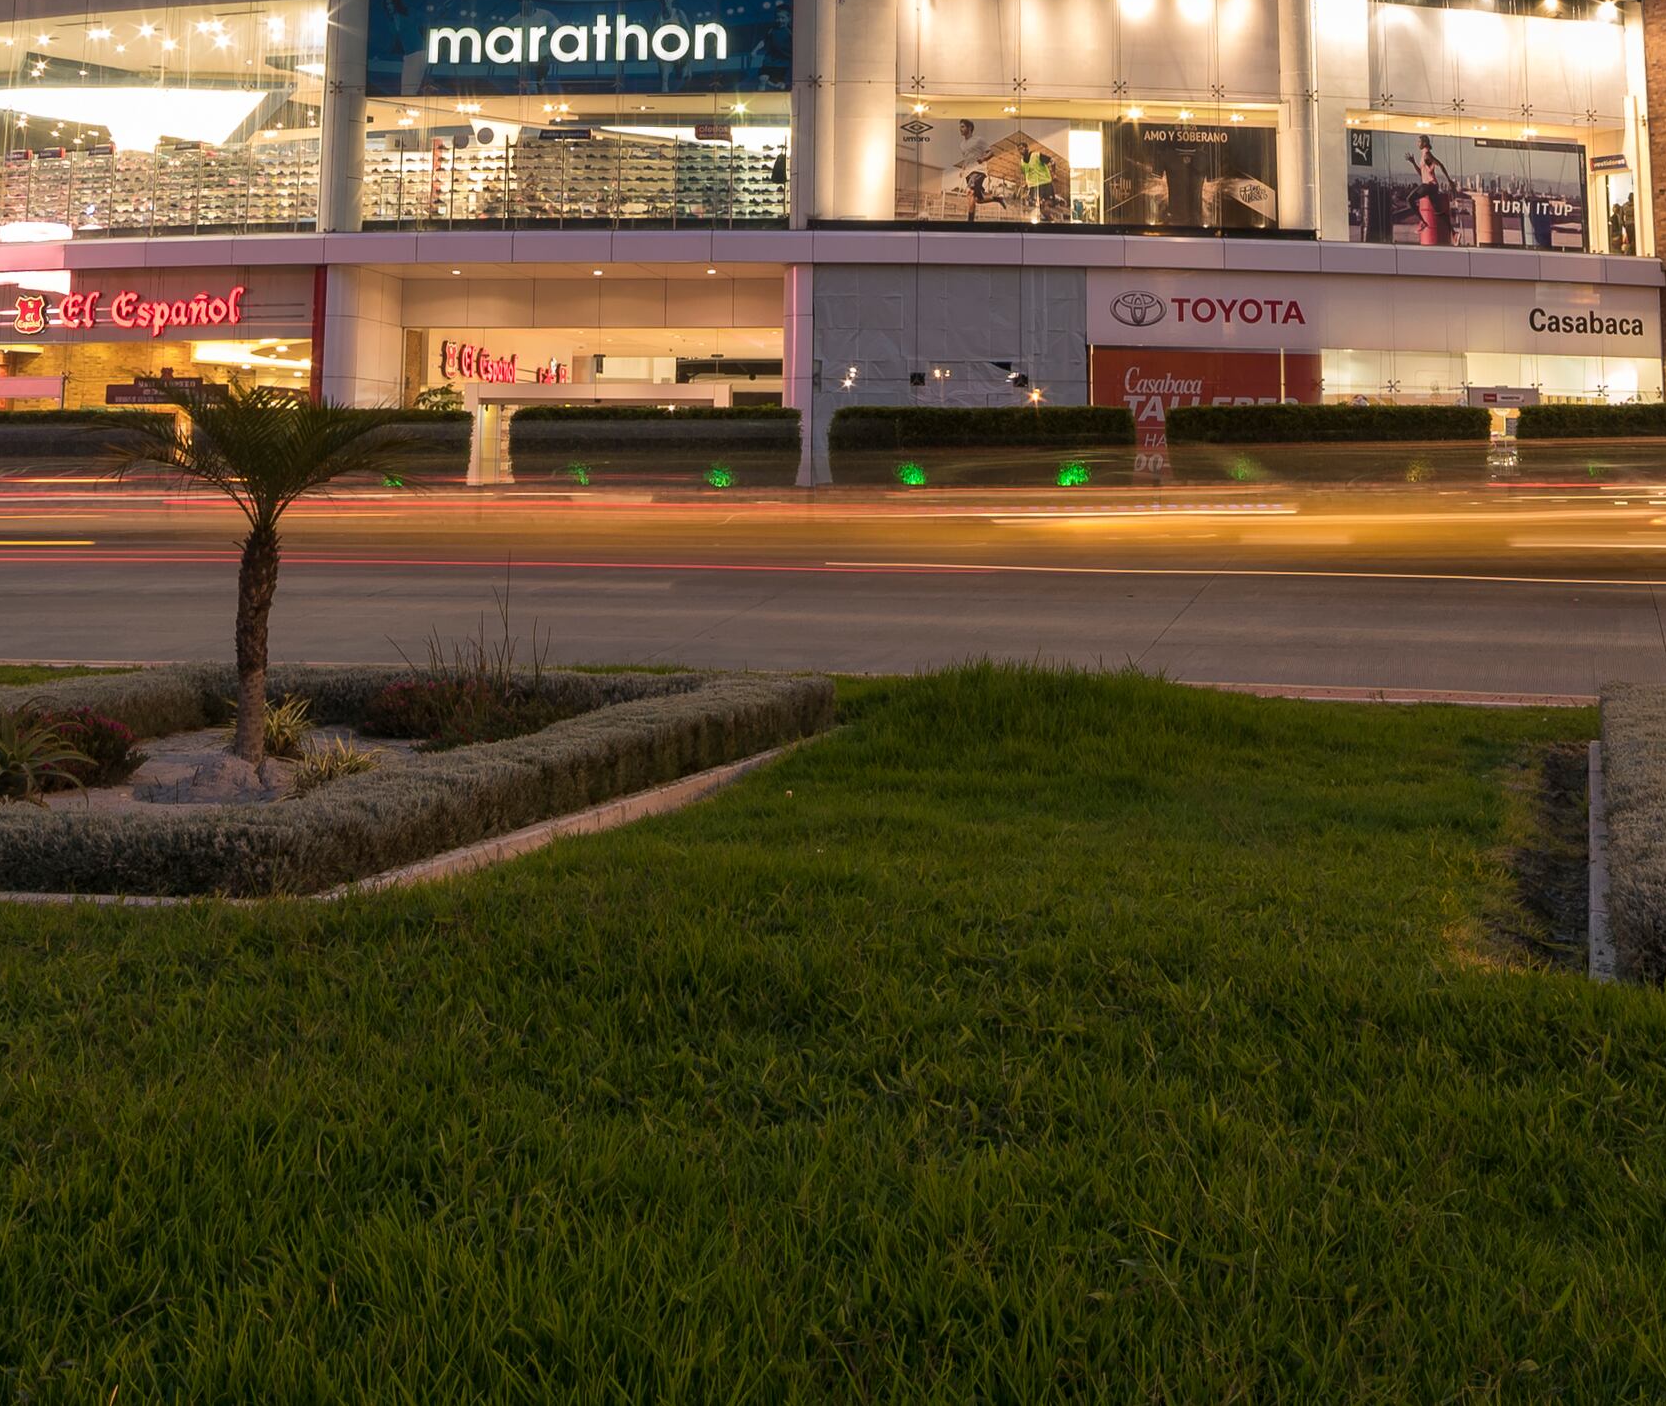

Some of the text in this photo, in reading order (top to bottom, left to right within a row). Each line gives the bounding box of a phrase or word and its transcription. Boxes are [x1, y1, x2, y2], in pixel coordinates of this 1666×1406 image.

[427, 14, 728, 64] marathon
[1144, 130, 1228, 143] AMO Y SOBERANO
[1352, 133, 1371, 149] 24/7
[1493, 199, 1531, 214] TURN
[1554, 203, 1573, 216] UP
[60, 286, 246, 338] El Español
[1171, 297, 1306, 326] TOYOTA
[1528, 307, 1644, 336] Casabaca
[1124, 366, 1203, 394] Casabaca
